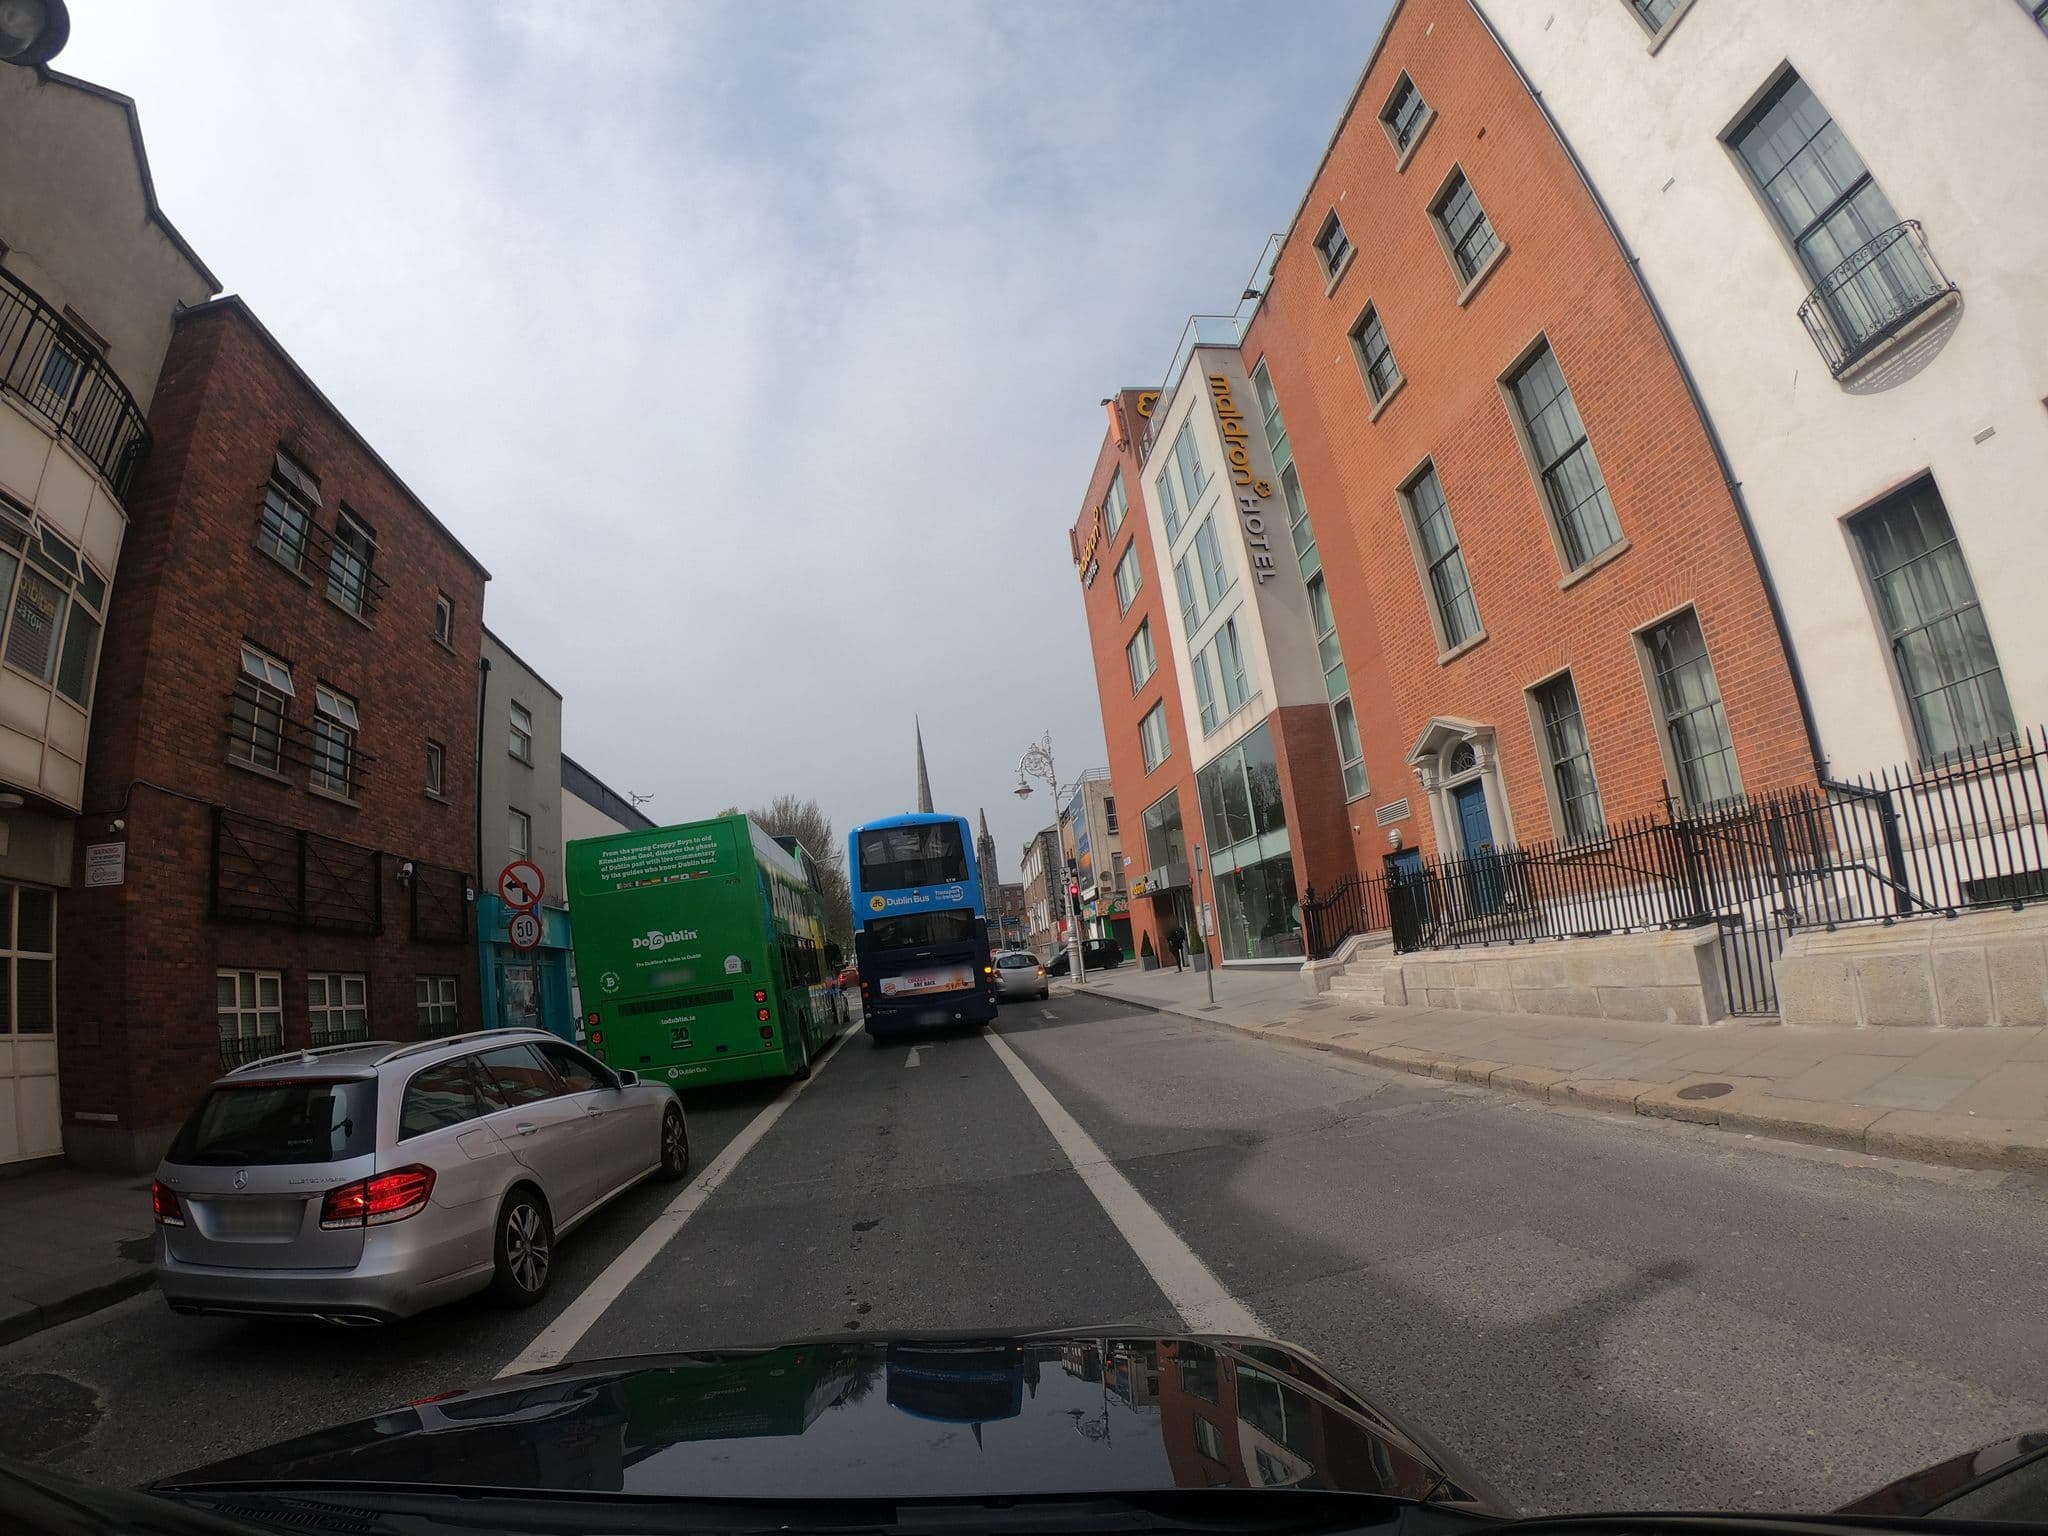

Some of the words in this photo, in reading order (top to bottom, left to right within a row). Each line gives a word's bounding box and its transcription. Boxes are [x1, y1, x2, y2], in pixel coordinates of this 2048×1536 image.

[1209, 374, 1253, 486] maldron
[1240, 496, 1276, 584] HOTEL
[598, 855, 637, 865] Kilmainham
[655, 848, 682, 856] discover
[695, 842, 717, 851] ghosts
[608, 862, 630, 871] Dublin
[674, 850, 715, 861] commentary
[622, 868, 644, 878] guides
[678, 860, 700, 868] Dublin
[887, 896, 912, 906] Dublin
[517, 920, 532, 938] 50
[632, 930, 697, 950] DoDublin
